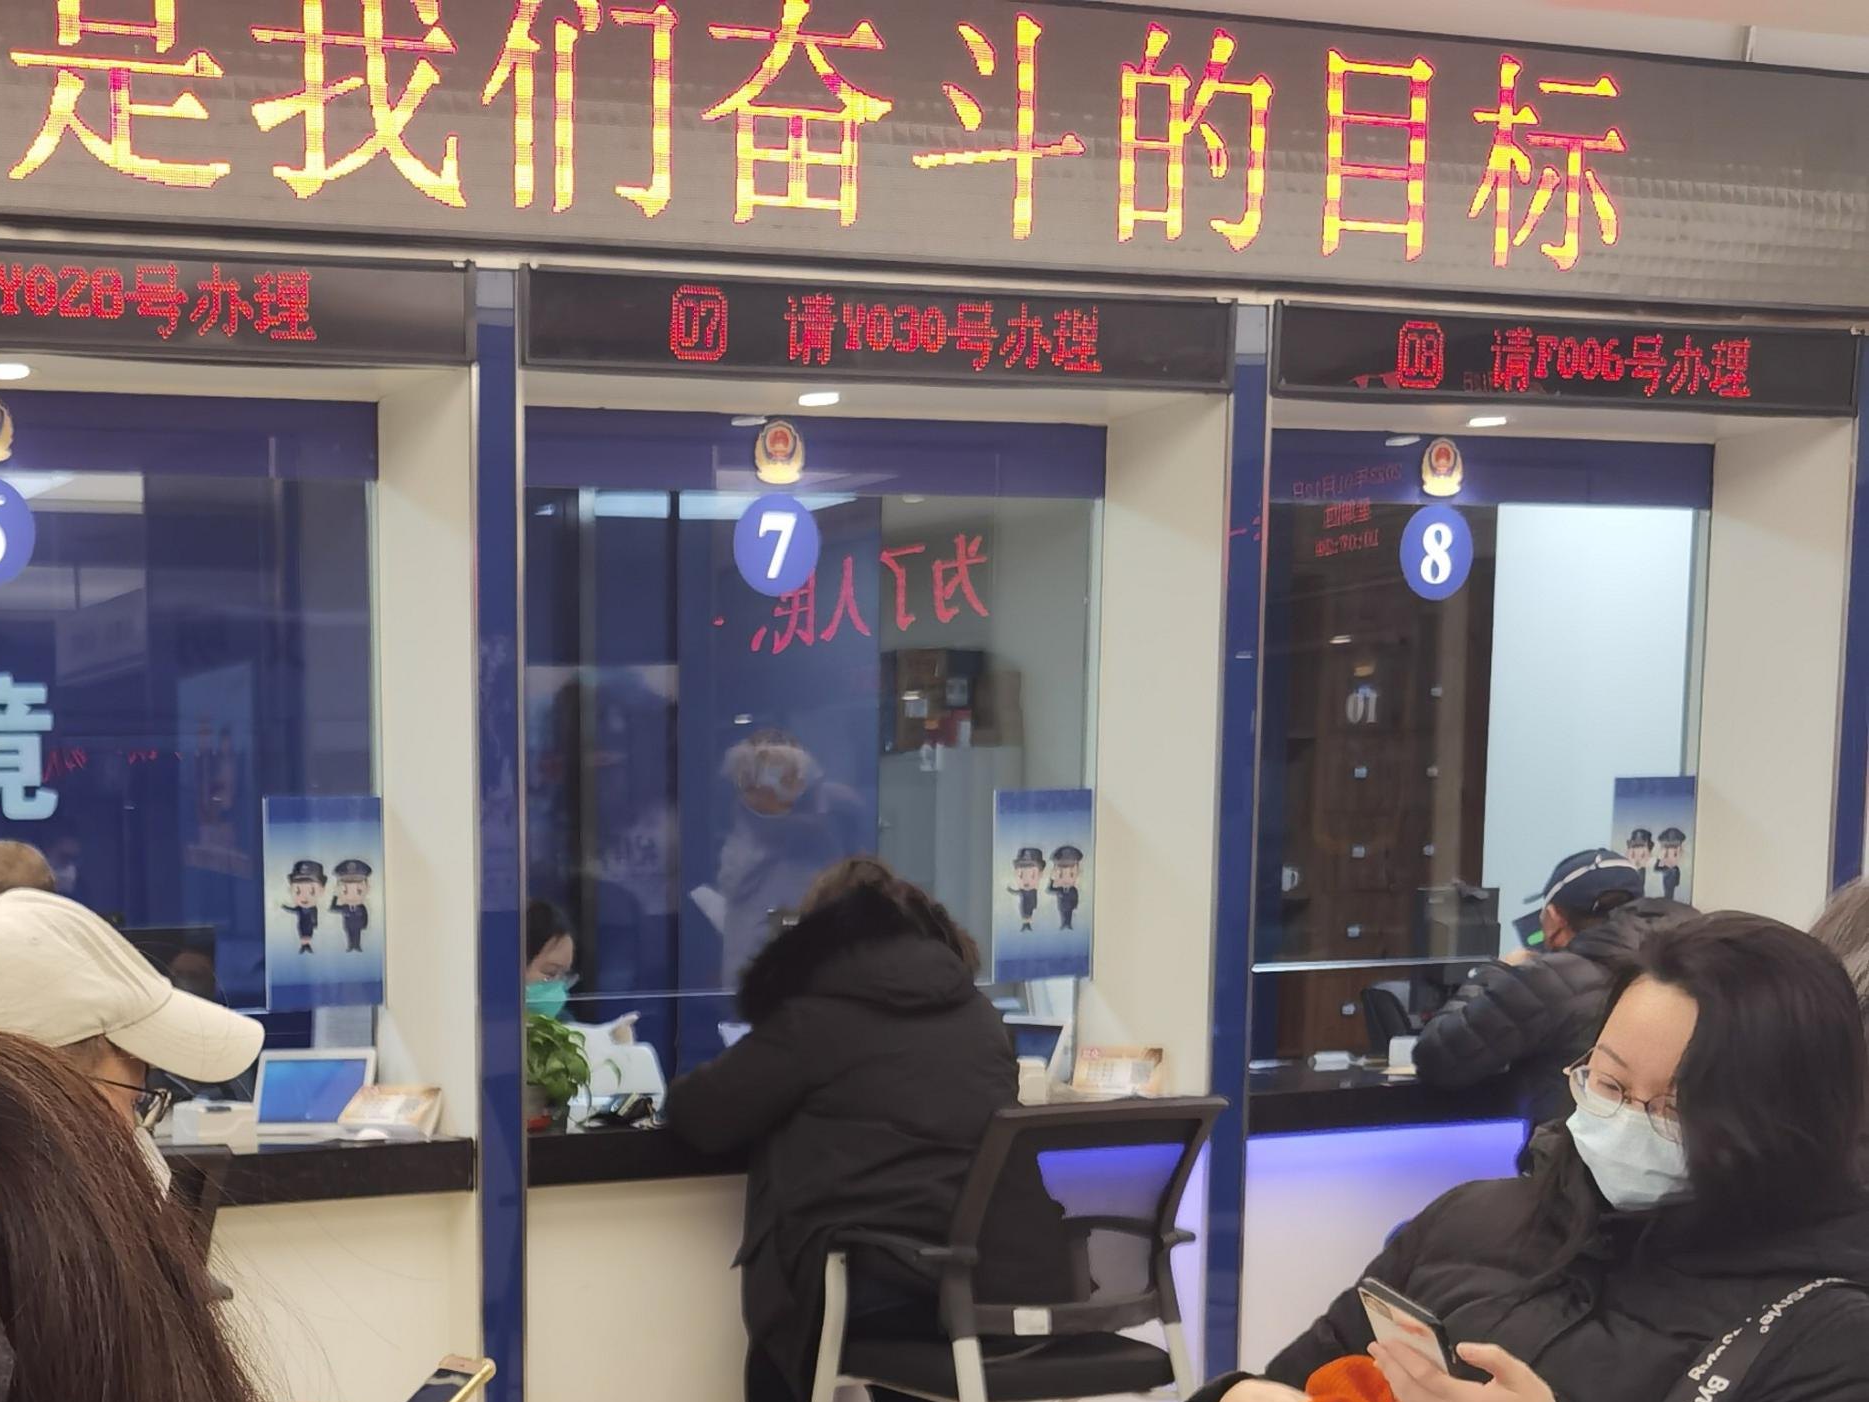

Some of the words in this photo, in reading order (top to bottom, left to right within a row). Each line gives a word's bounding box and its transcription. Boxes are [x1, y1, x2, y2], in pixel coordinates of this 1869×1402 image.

[679, 300, 721, 348] 07
[784, 292, 1103, 373] 请Y030号办理
[1405, 330, 1439, 373] 08
[757, 511, 797, 579] 7
[1420, 522, 1454, 584] 8
